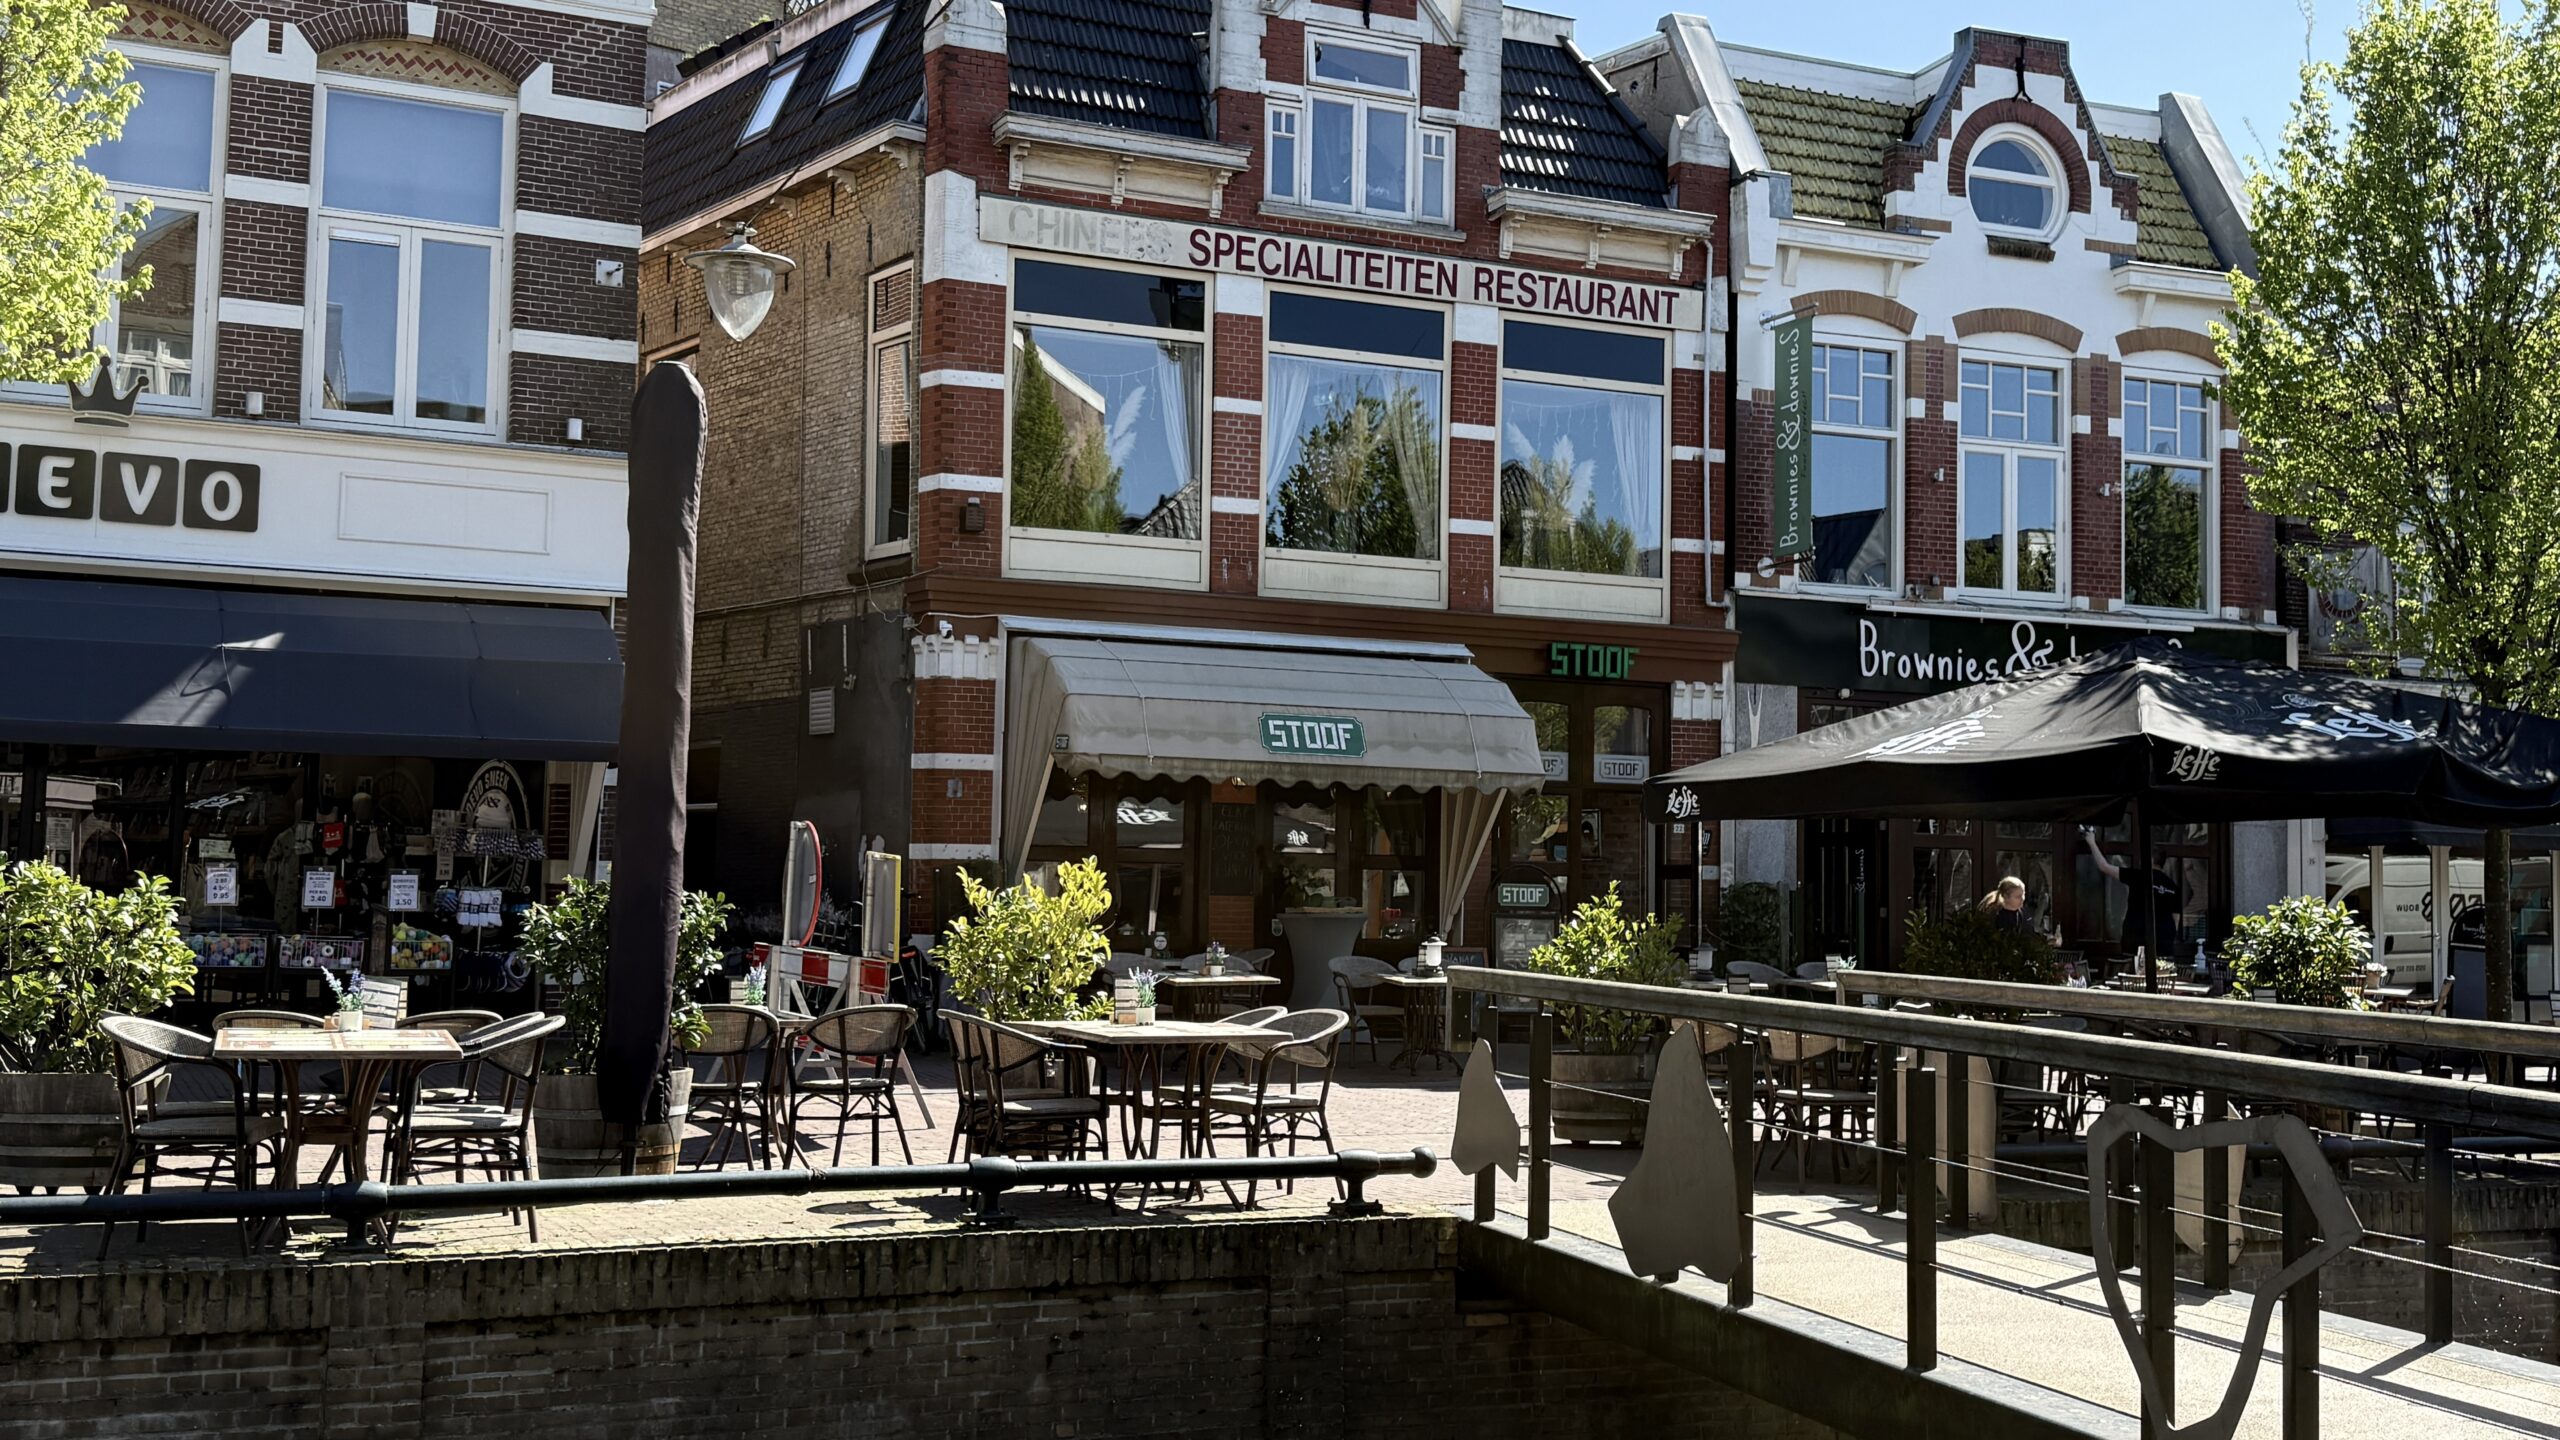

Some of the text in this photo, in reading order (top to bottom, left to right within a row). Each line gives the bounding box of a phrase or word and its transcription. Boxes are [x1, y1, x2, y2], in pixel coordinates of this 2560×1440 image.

[1188, 228, 1459, 298] SPECIALITEITEN
[1473, 266, 1680, 325] RESTAURANT
[1550, 642, 1640, 679] STOOF
[1268, 719, 1355, 751] STOOF
[1603, 761, 1640, 777] STOOF
[2167, 745, 2221, 782] Leffe
[1665, 785, 1699, 819] Leffe
[1502, 886, 1545, 903] STOOF
